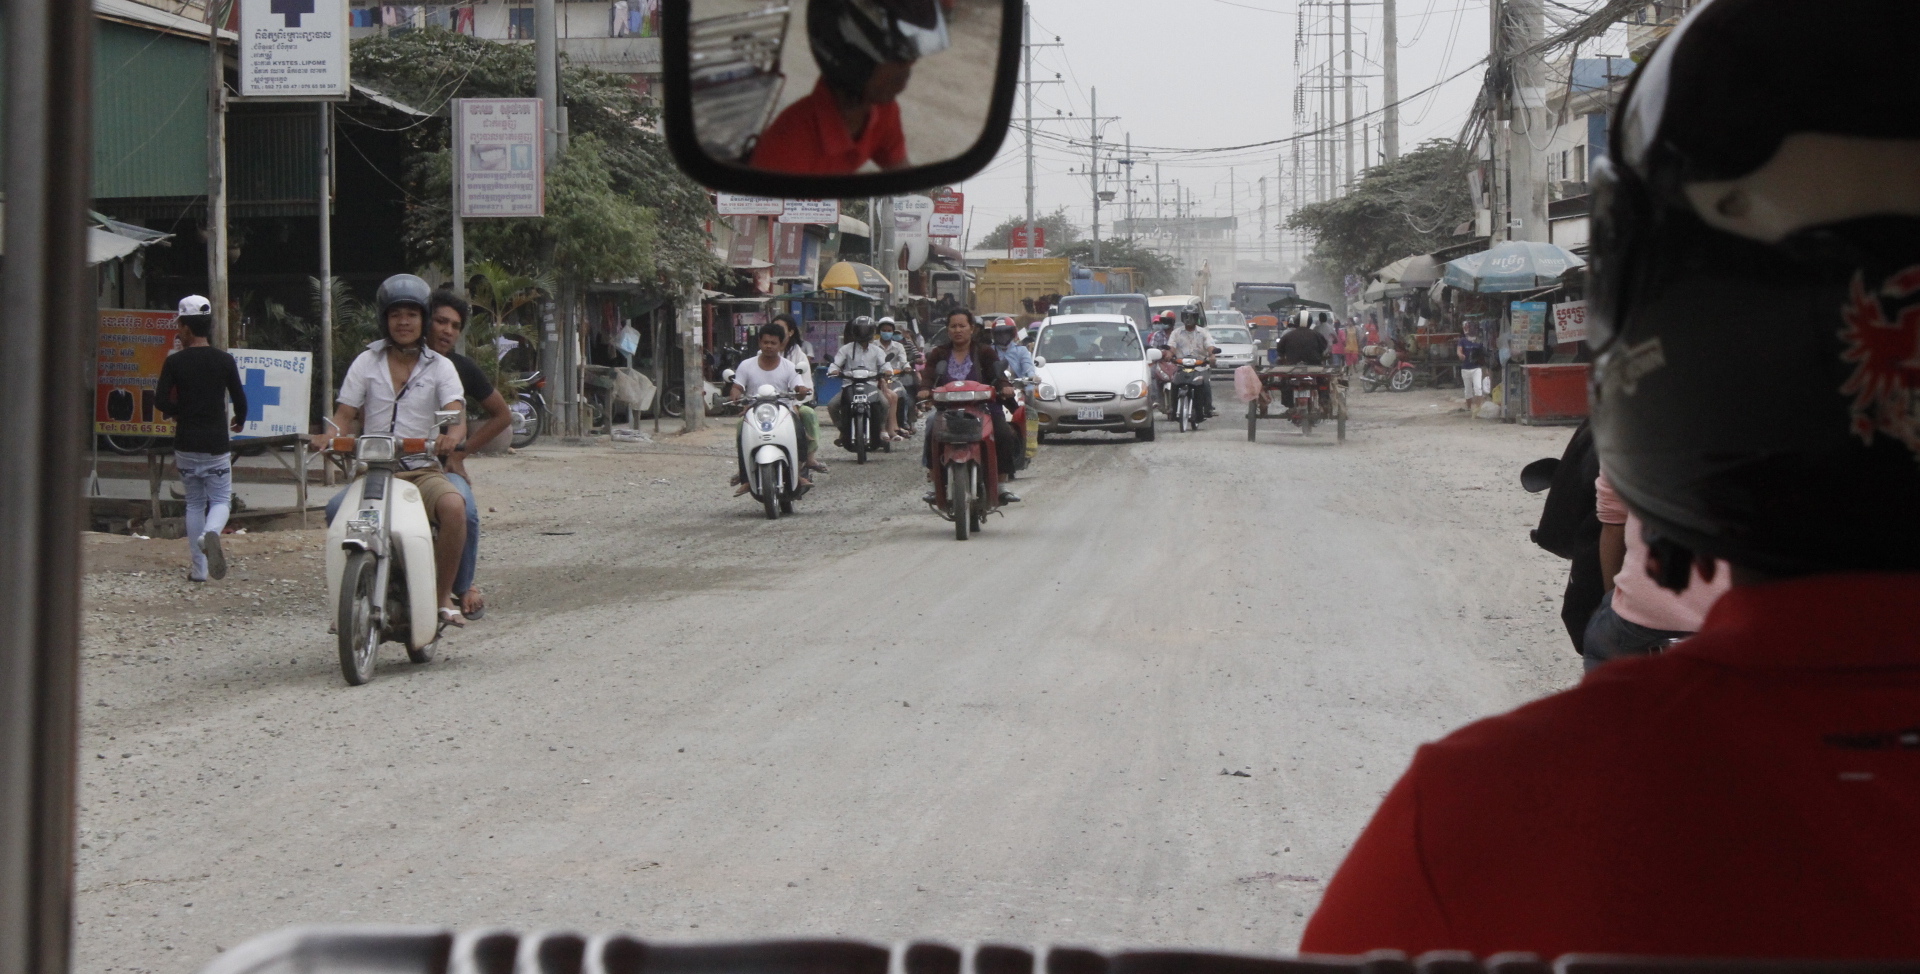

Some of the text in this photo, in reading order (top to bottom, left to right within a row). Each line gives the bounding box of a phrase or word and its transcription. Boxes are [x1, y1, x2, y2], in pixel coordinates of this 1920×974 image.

[146, 318, 154, 329] &
[100, 423, 117, 431] Tel:
[120, 424, 137, 432] 076
